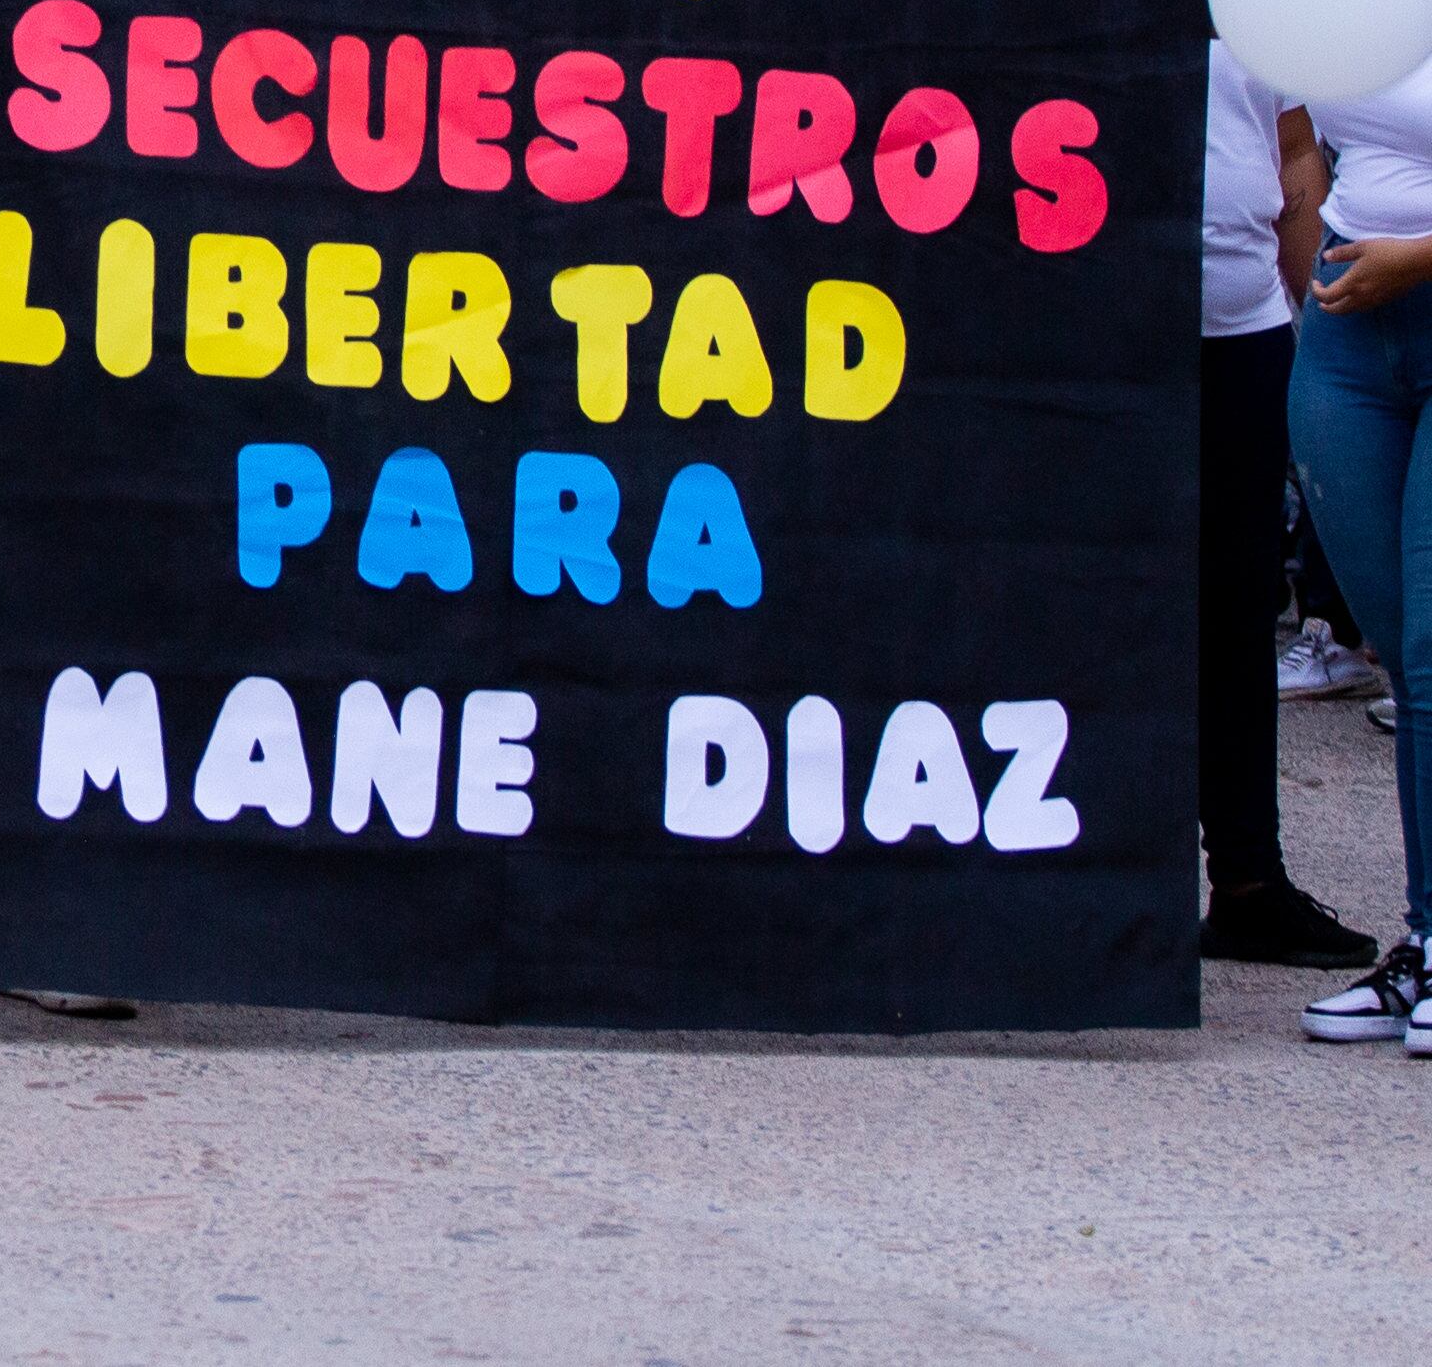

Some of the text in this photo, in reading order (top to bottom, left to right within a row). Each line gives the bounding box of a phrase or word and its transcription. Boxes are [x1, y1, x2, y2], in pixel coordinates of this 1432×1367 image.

[8, 0, 1108, 252] SECUESTROS
[237, 443, 762, 608] PARA
[37, 667, 1080, 853] MANE DIAZ
